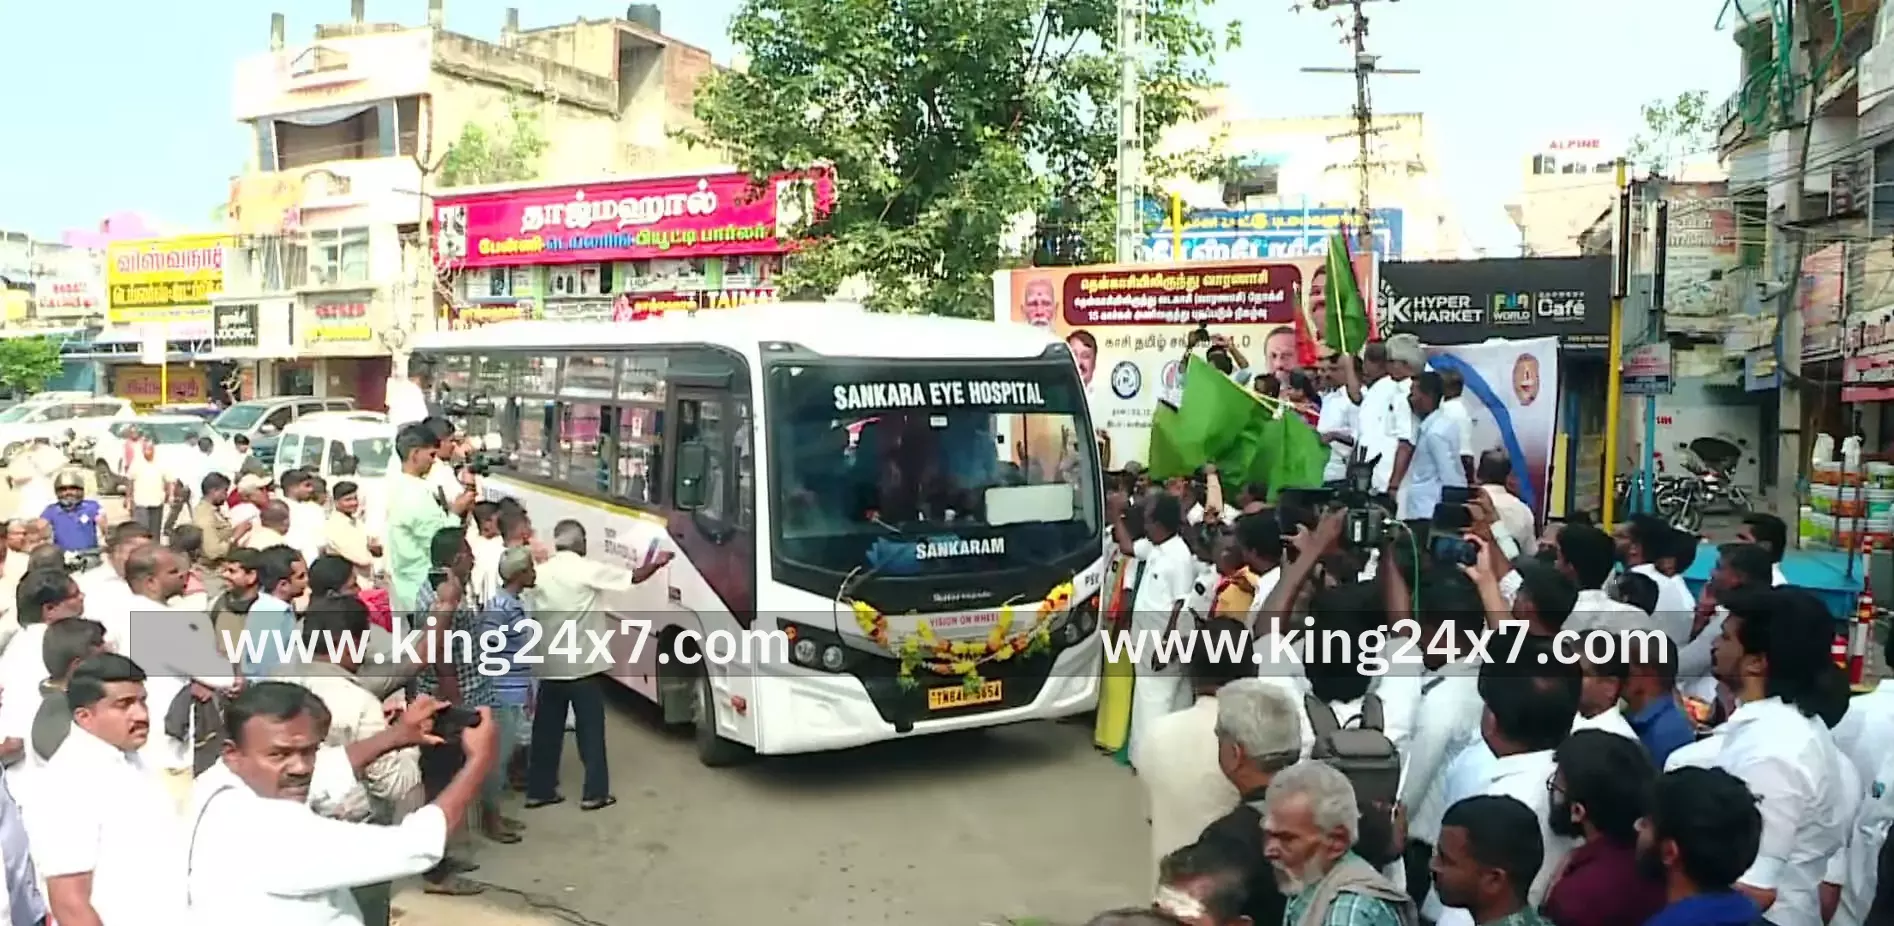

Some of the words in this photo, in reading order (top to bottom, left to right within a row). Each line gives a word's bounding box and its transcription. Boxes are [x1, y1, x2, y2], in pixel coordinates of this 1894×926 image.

[1549, 139, 1600, 149] ALPINE
[521, 178, 717, 233] தாஜ்மஹால்
[1080, 272, 1199, 292] தென்காசியிலிருந்து
[1203, 270, 1269, 289] வாரணாசி
[1414, 296, 1470, 309] HYPER
[1538, 299, 1585, 317] Café
[1088, 311, 1100, 321] 15
[1413, 309, 1484, 323] MARKET
[1493, 311, 1530, 320] WORLD
[1105, 333, 1132, 348] காசி
[1134, 333, 1167, 352] தமிழ்
[833, 382, 926, 410] SANKARA
[929, 381, 965, 406] EYE
[968, 381, 1045, 405] HOSPITAL
[915, 537, 1005, 560] SANKARAM
[929, 614, 957, 627] VISION
[960, 613, 972, 625] ON
